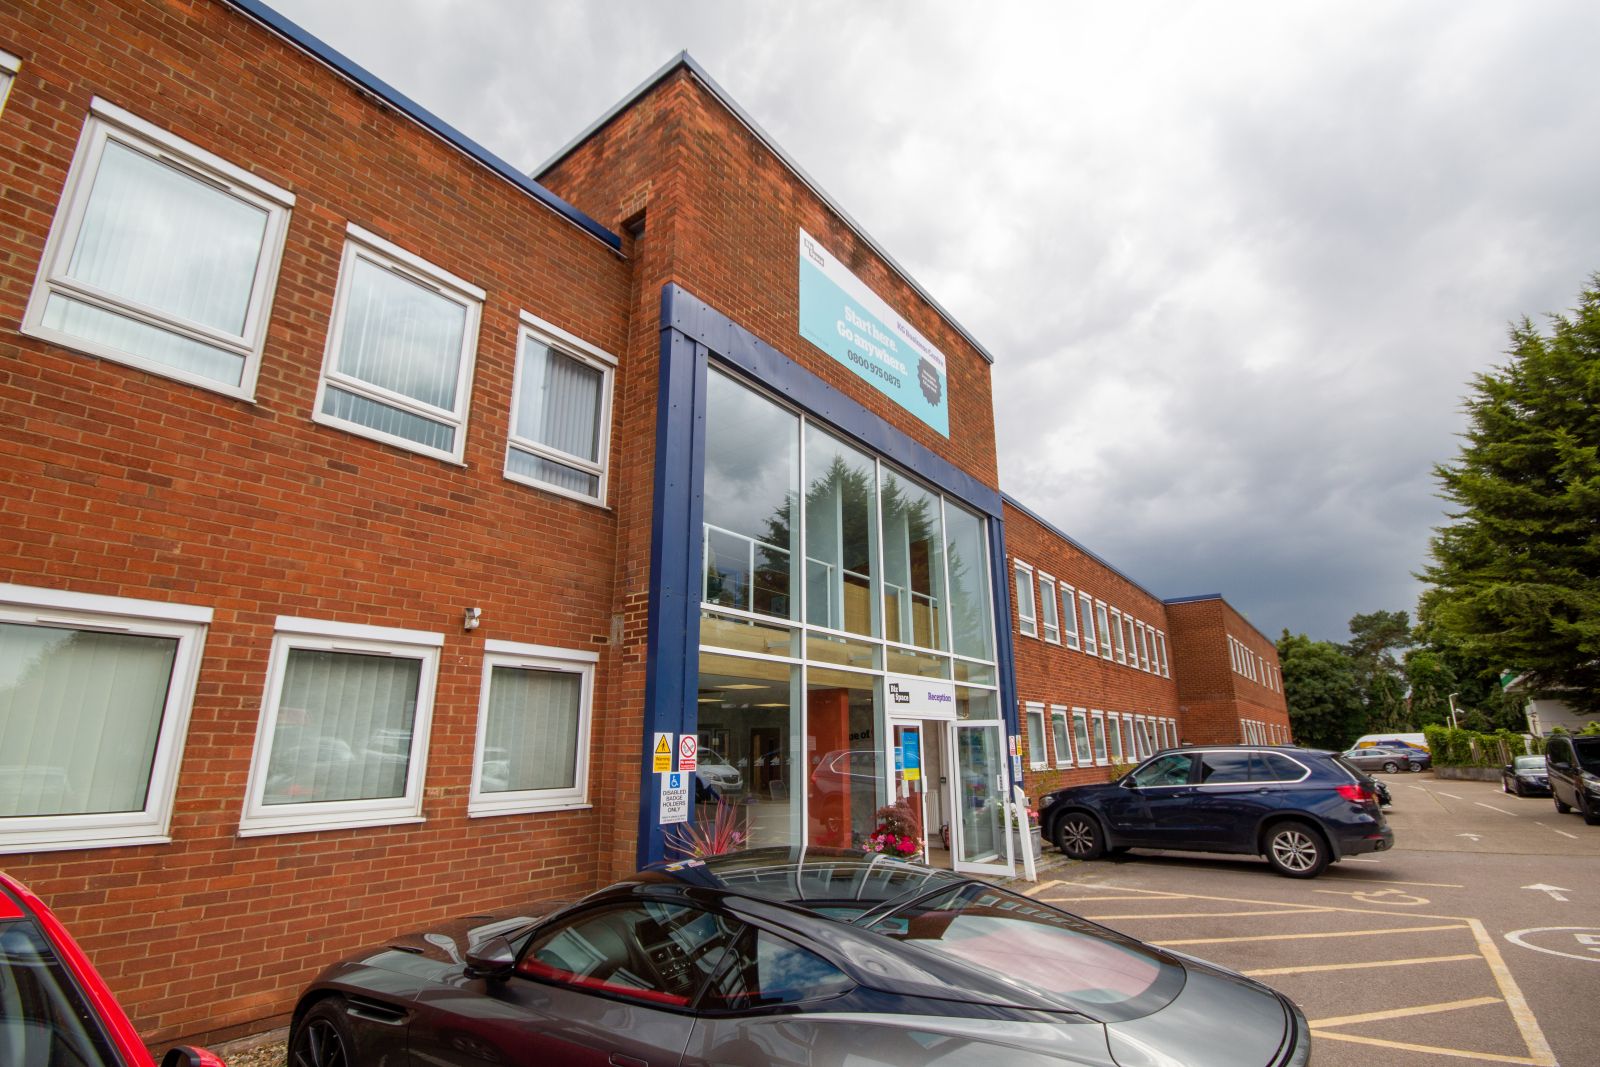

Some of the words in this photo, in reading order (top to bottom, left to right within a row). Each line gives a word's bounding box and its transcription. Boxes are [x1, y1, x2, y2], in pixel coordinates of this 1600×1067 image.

[844, 305, 872, 334] Start
[872, 324, 898, 352] here.
[837, 320, 853, 341] Go
[854, 333, 908, 376] anywhere.
[847, 349, 869, 370] 0800
[870, 363, 884, 378] 975
[884, 371, 901, 389] 0875
[890, 684, 899, 693] Biz
[896, 694, 909, 703] Space
[928, 692, 951, 703] Reception
